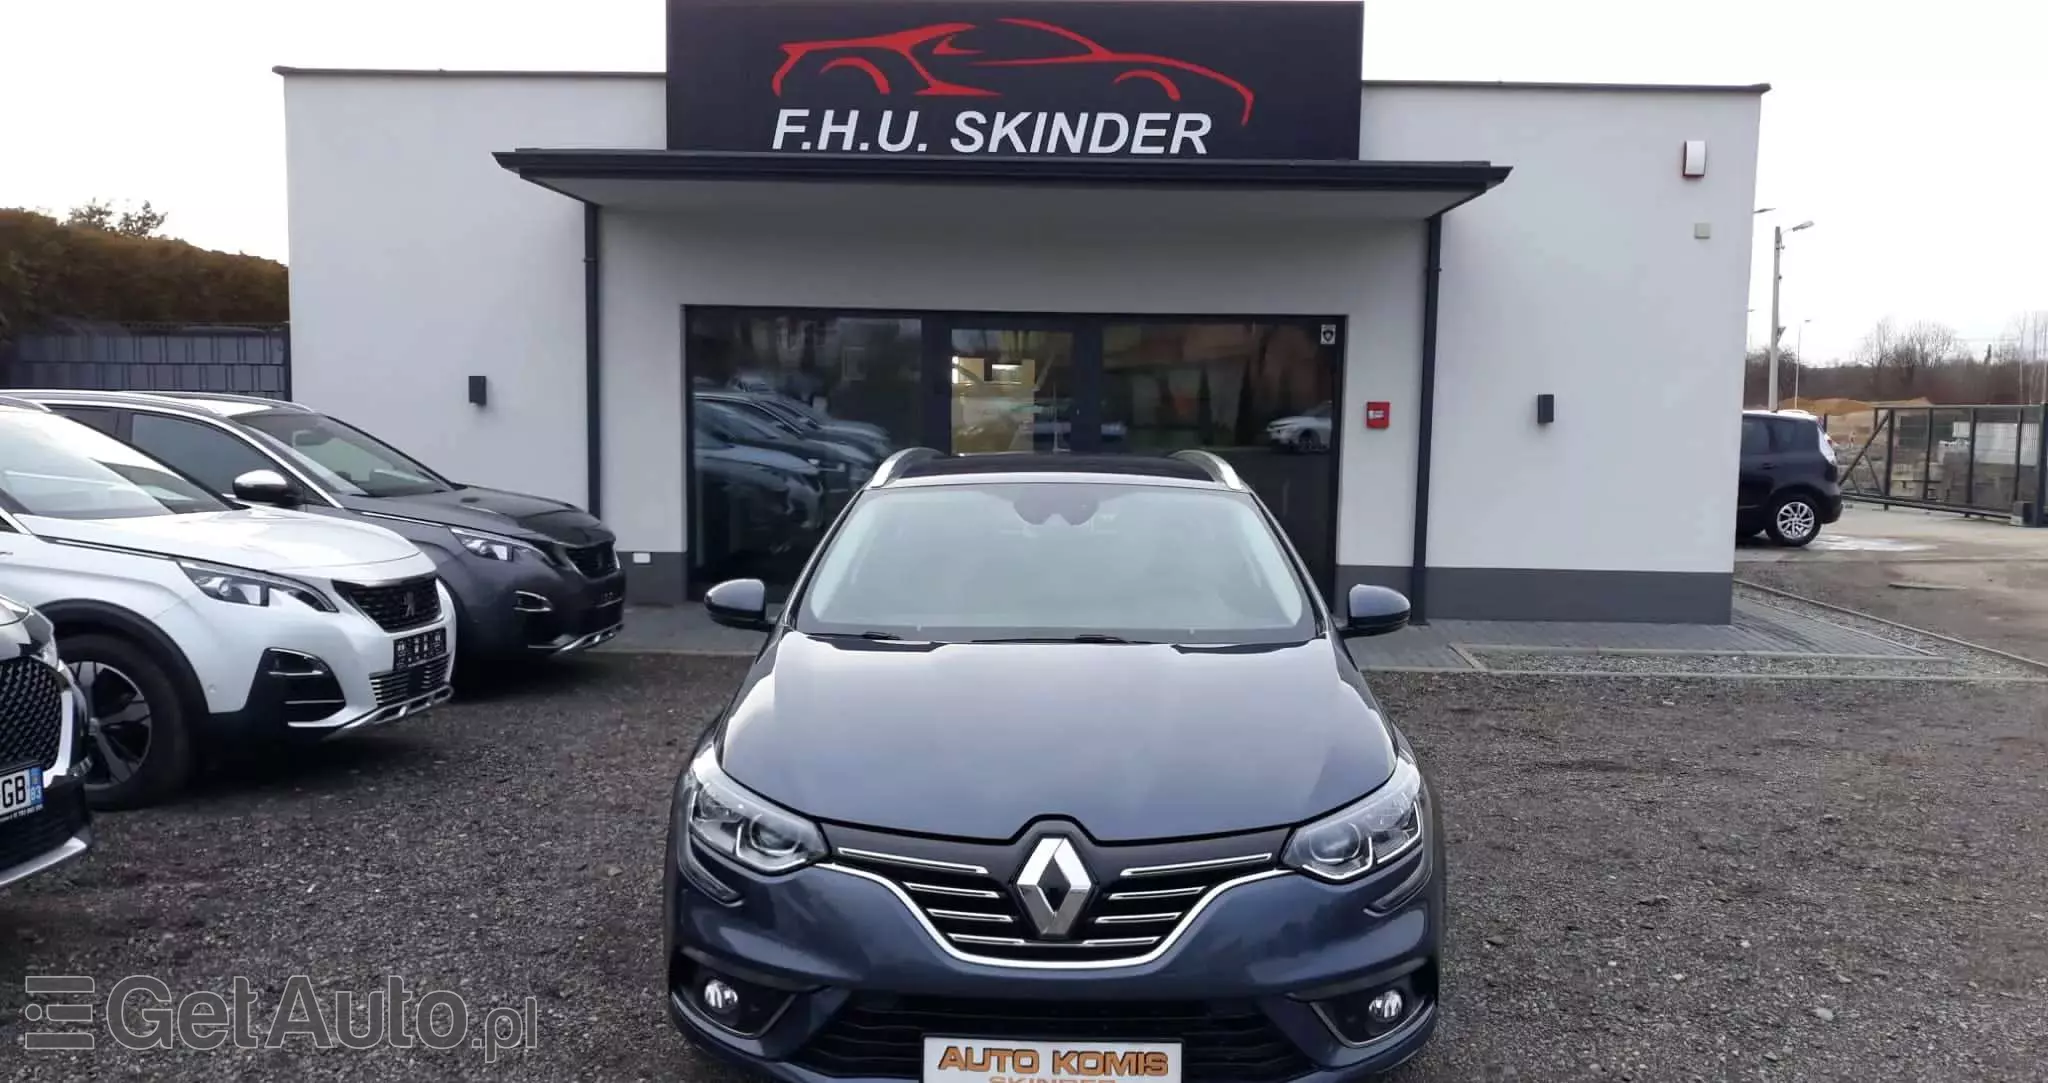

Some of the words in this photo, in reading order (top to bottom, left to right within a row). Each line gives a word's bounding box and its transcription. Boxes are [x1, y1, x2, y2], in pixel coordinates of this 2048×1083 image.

[772, 109, 928, 152] F.H.U.
[950, 110, 1213, 155] SKINDER
[938, 1046, 1040, 1074] AUTO
[1051, 1050, 1169, 1077] KOMIS
